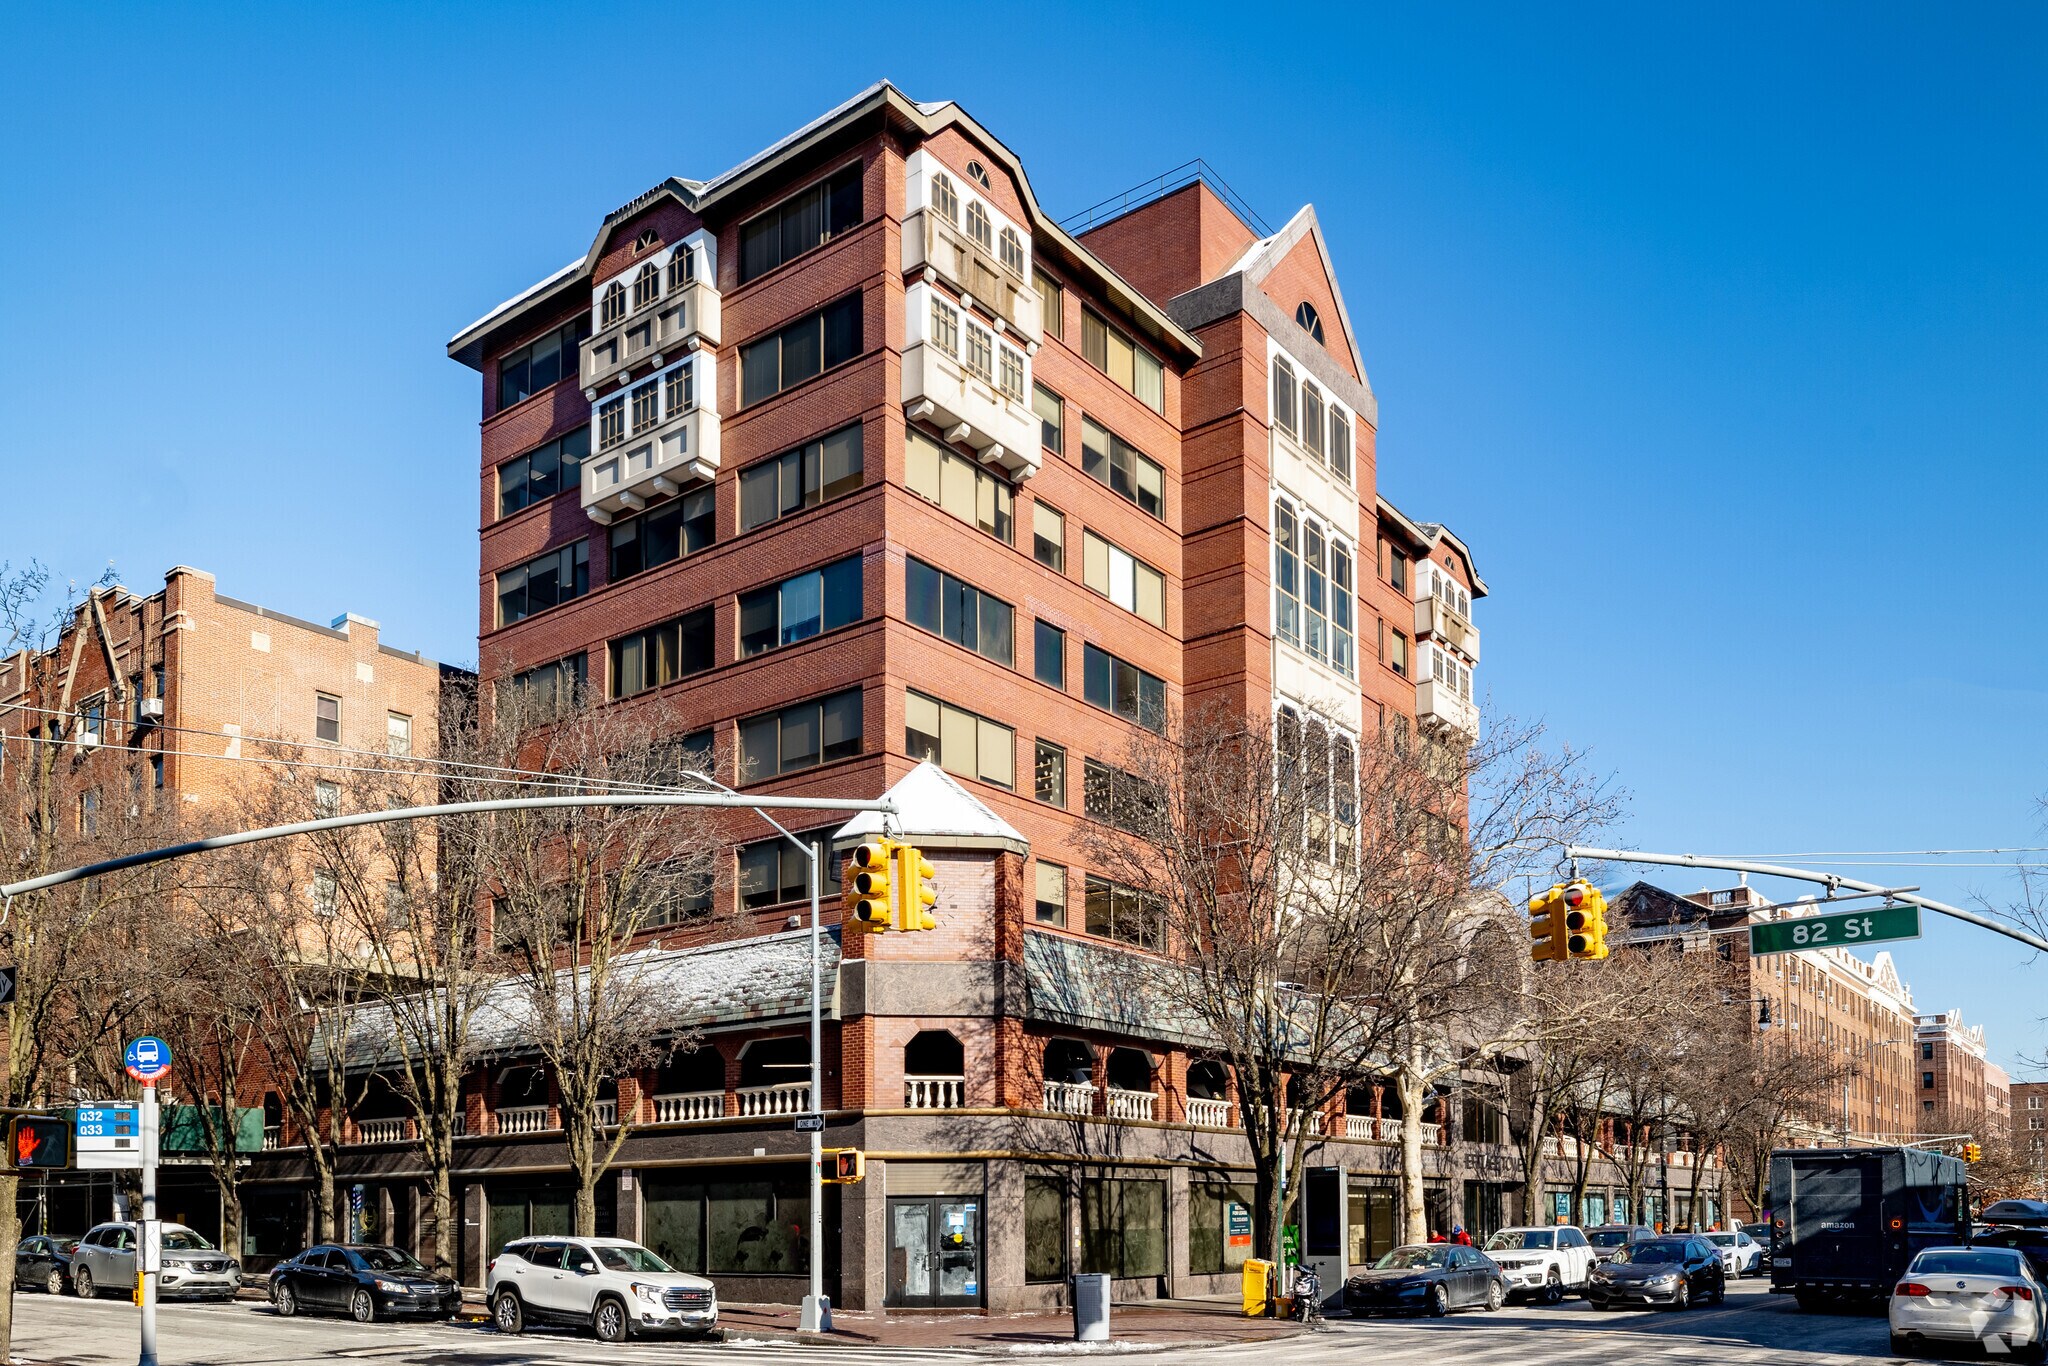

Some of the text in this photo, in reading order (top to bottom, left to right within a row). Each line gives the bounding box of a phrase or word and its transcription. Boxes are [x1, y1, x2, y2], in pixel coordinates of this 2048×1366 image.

[1793, 917, 1873, 944] 82 St
[130, 1066, 167, 1080] NO STANDING
[80, 1110, 103, 1121] Q32
[80, 1124, 103, 1135] Q33
[800, 1120, 809, 1128] ONE
[1821, 1221, 1855, 1229] amazon
